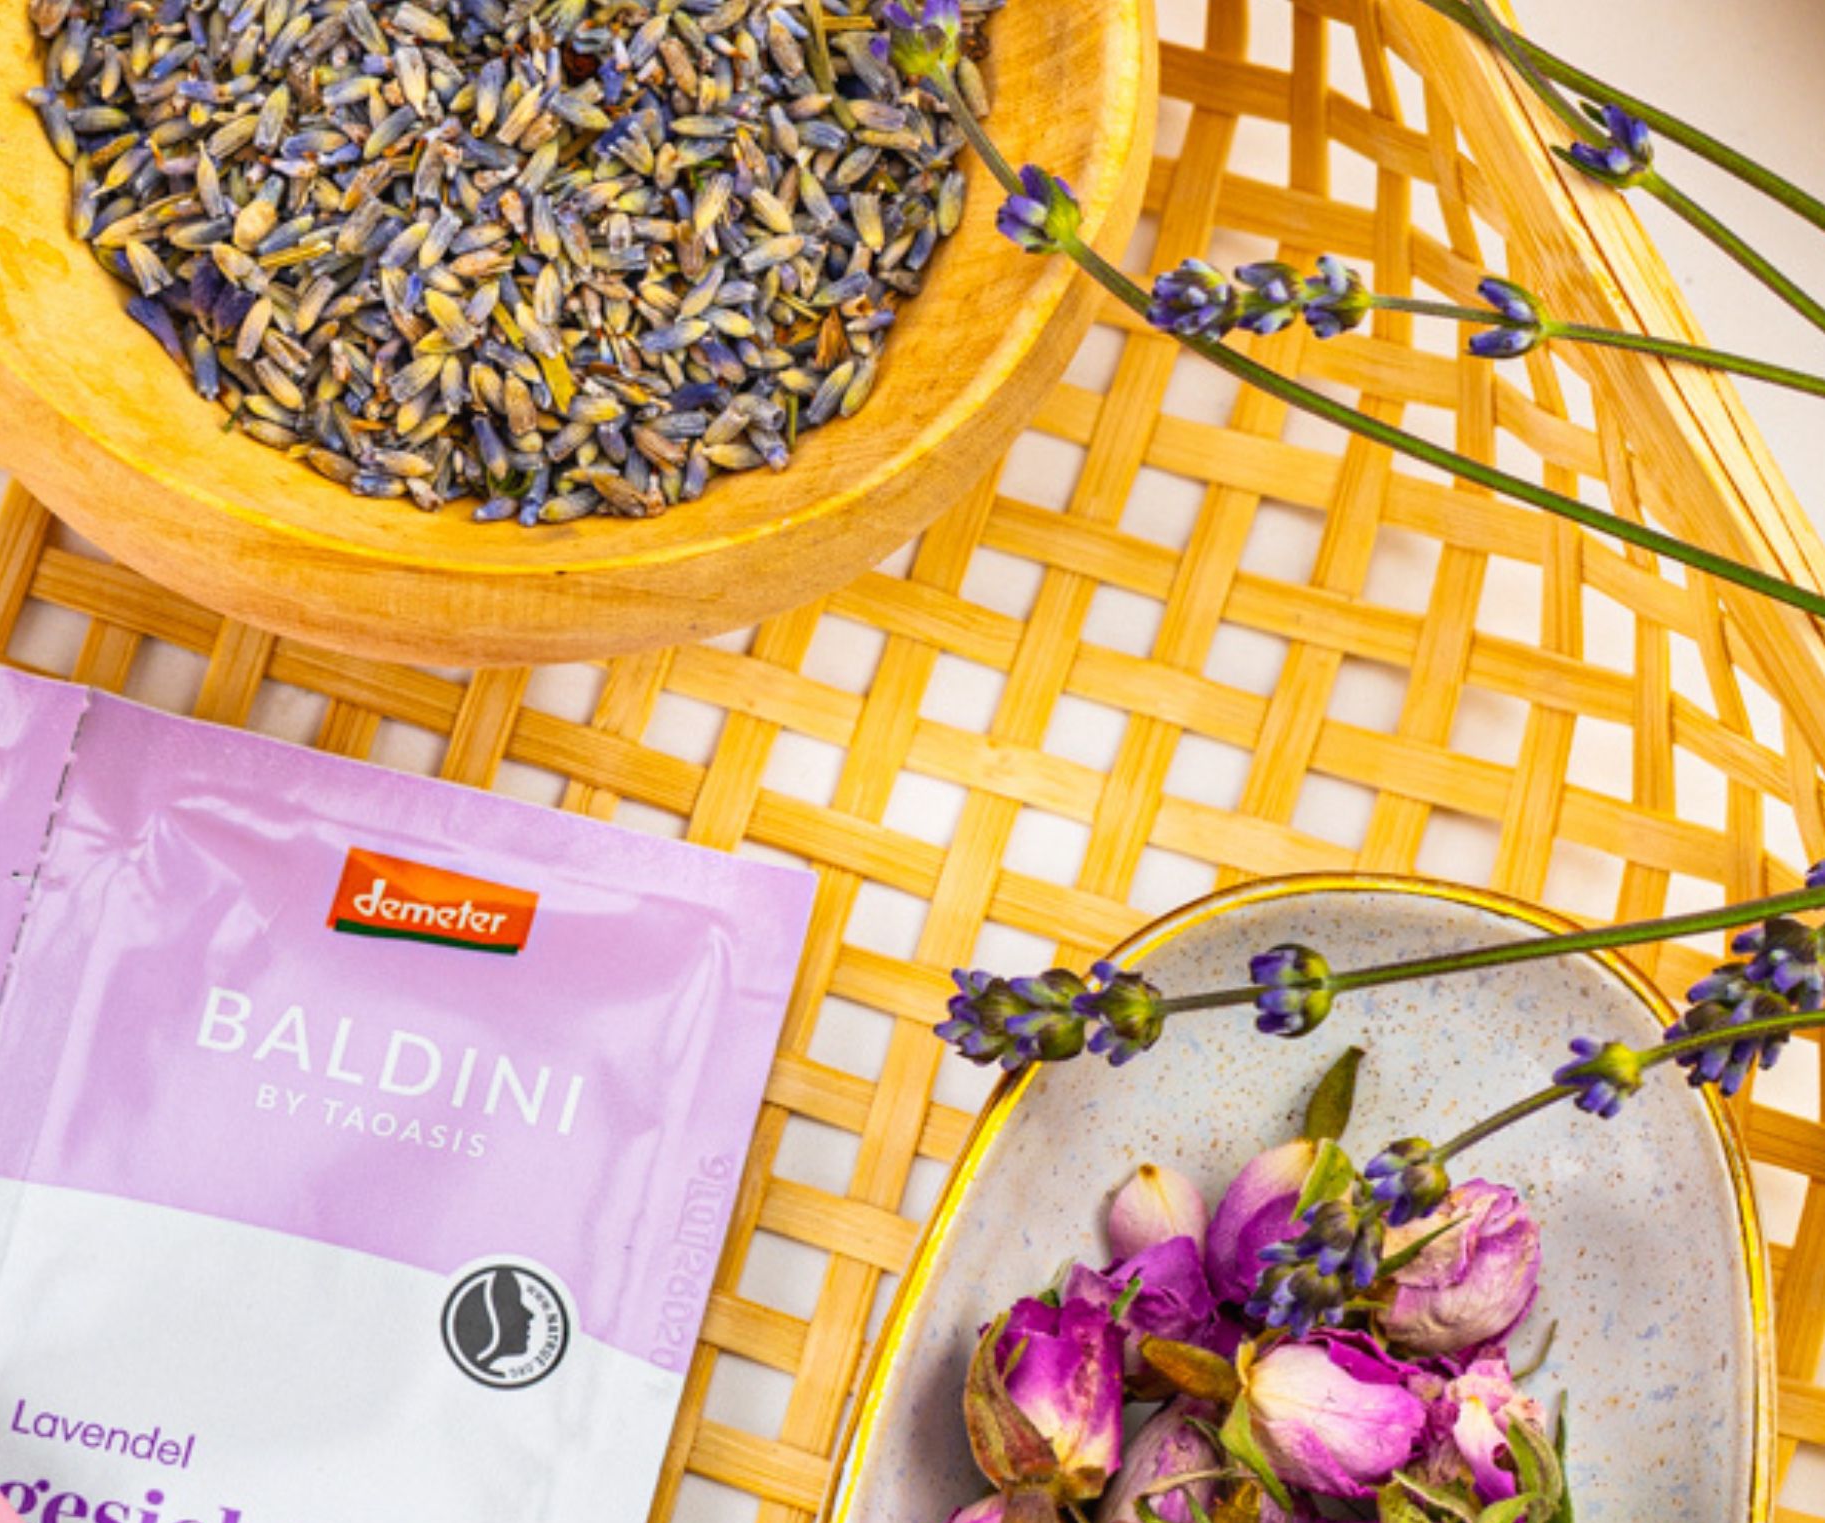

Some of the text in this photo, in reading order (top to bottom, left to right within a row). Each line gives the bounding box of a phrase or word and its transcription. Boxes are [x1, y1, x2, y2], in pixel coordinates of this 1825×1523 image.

[353, 878, 507, 936] demeter
[195, 985, 585, 1136] BALDINI
[255, 1083, 489, 1158] BY TAOASIS
[10, 1399, 195, 1469] Lavendel
